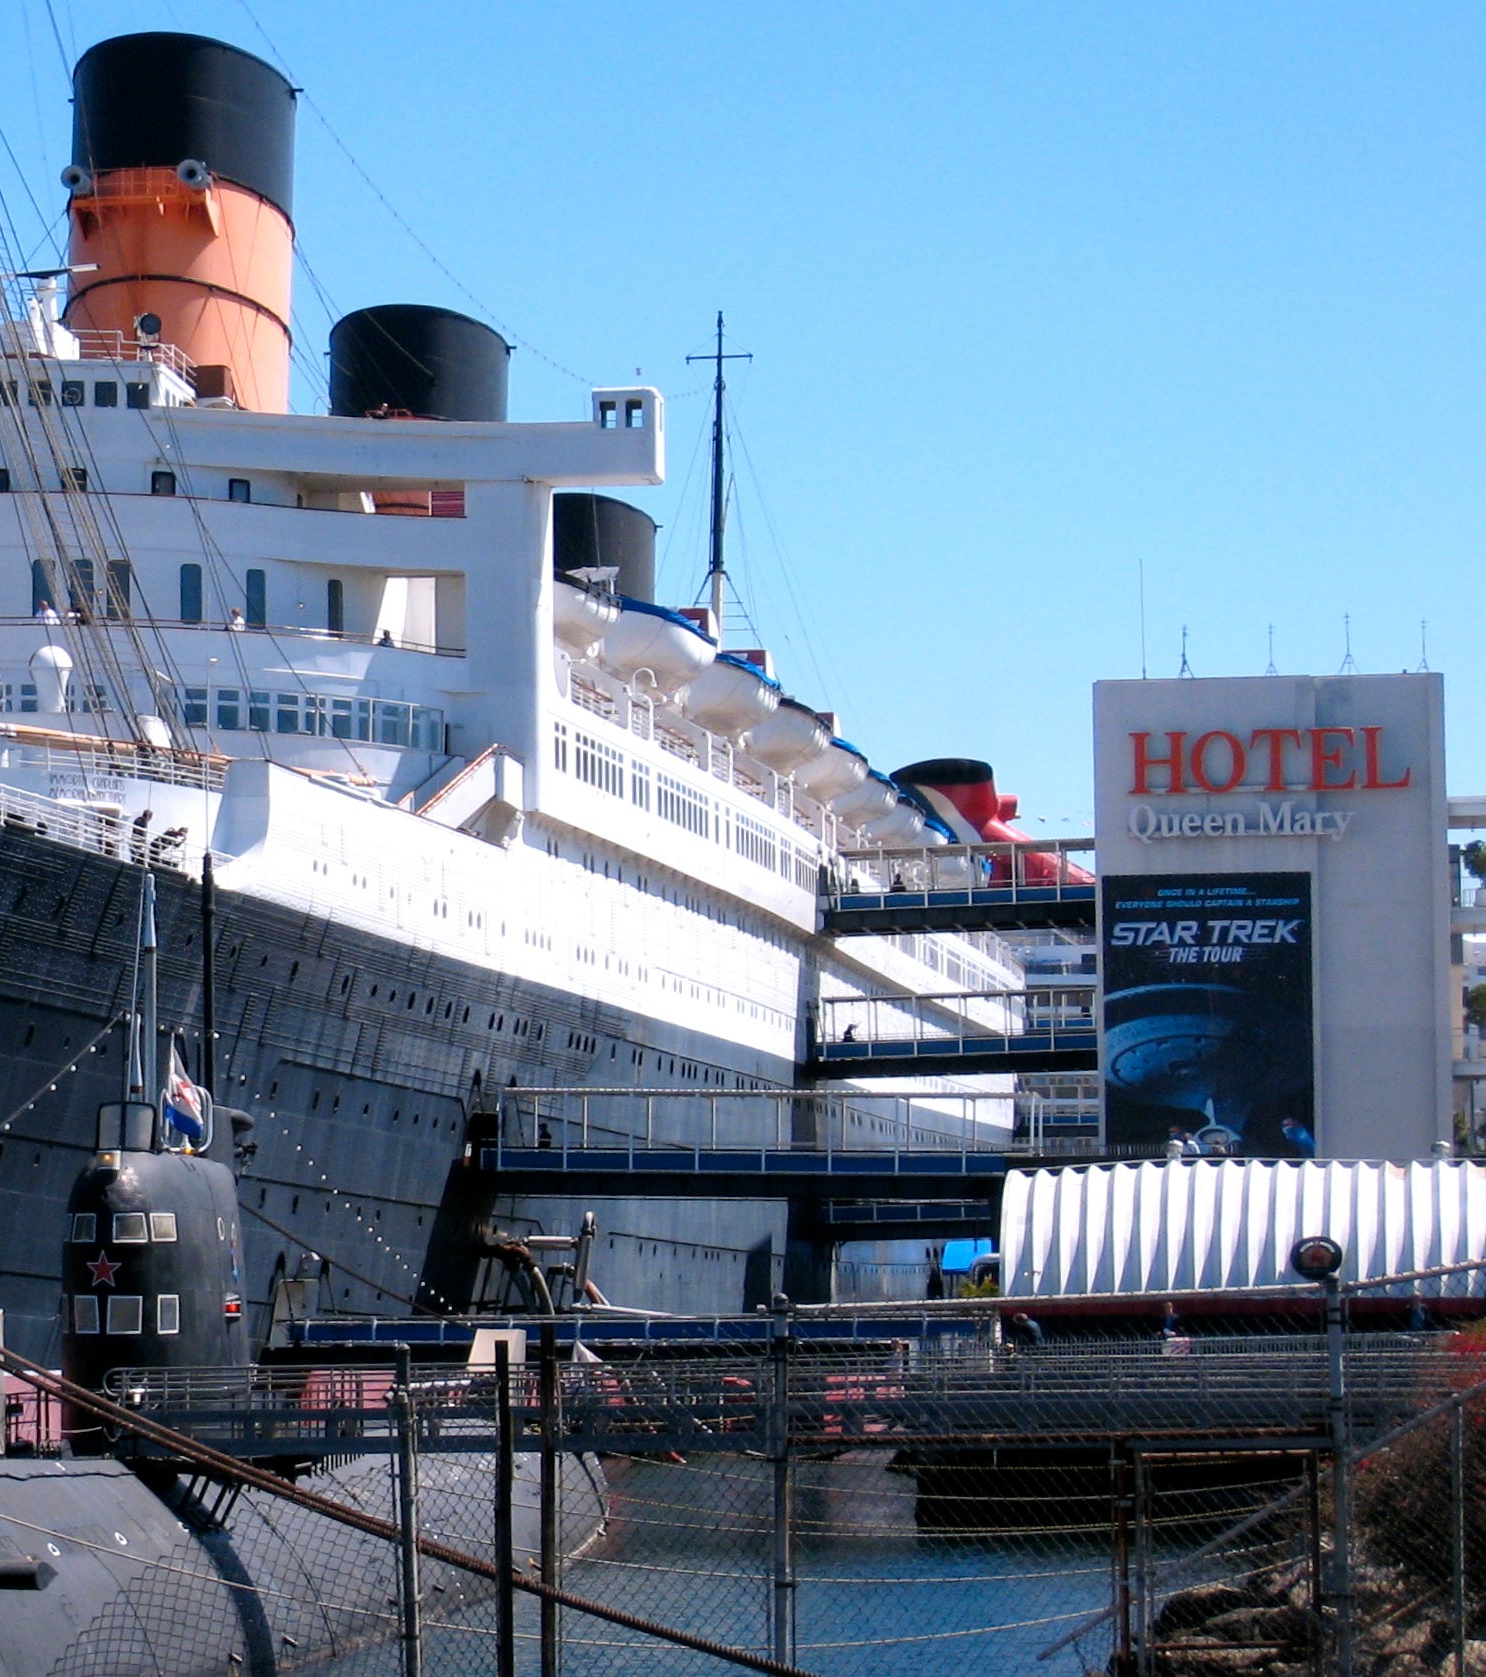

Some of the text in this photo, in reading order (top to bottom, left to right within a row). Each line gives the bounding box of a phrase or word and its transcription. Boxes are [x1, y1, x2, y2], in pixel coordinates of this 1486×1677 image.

[1128, 726, 1411, 795] HOTEL
[1128, 801, 1356, 844] Queen Mary
[1157, 888, 1183, 897] ONCE
[1185, 888, 1196, 896] IN
[1198, 887, 1205, 896] A
[1115, 898, 1300, 910] EVERYONE SHOULD CAPTAIN A STARSHIP
[1111, 919, 1302, 946] STAR TREK
[1169, 946, 1243, 964] THE TOUR
